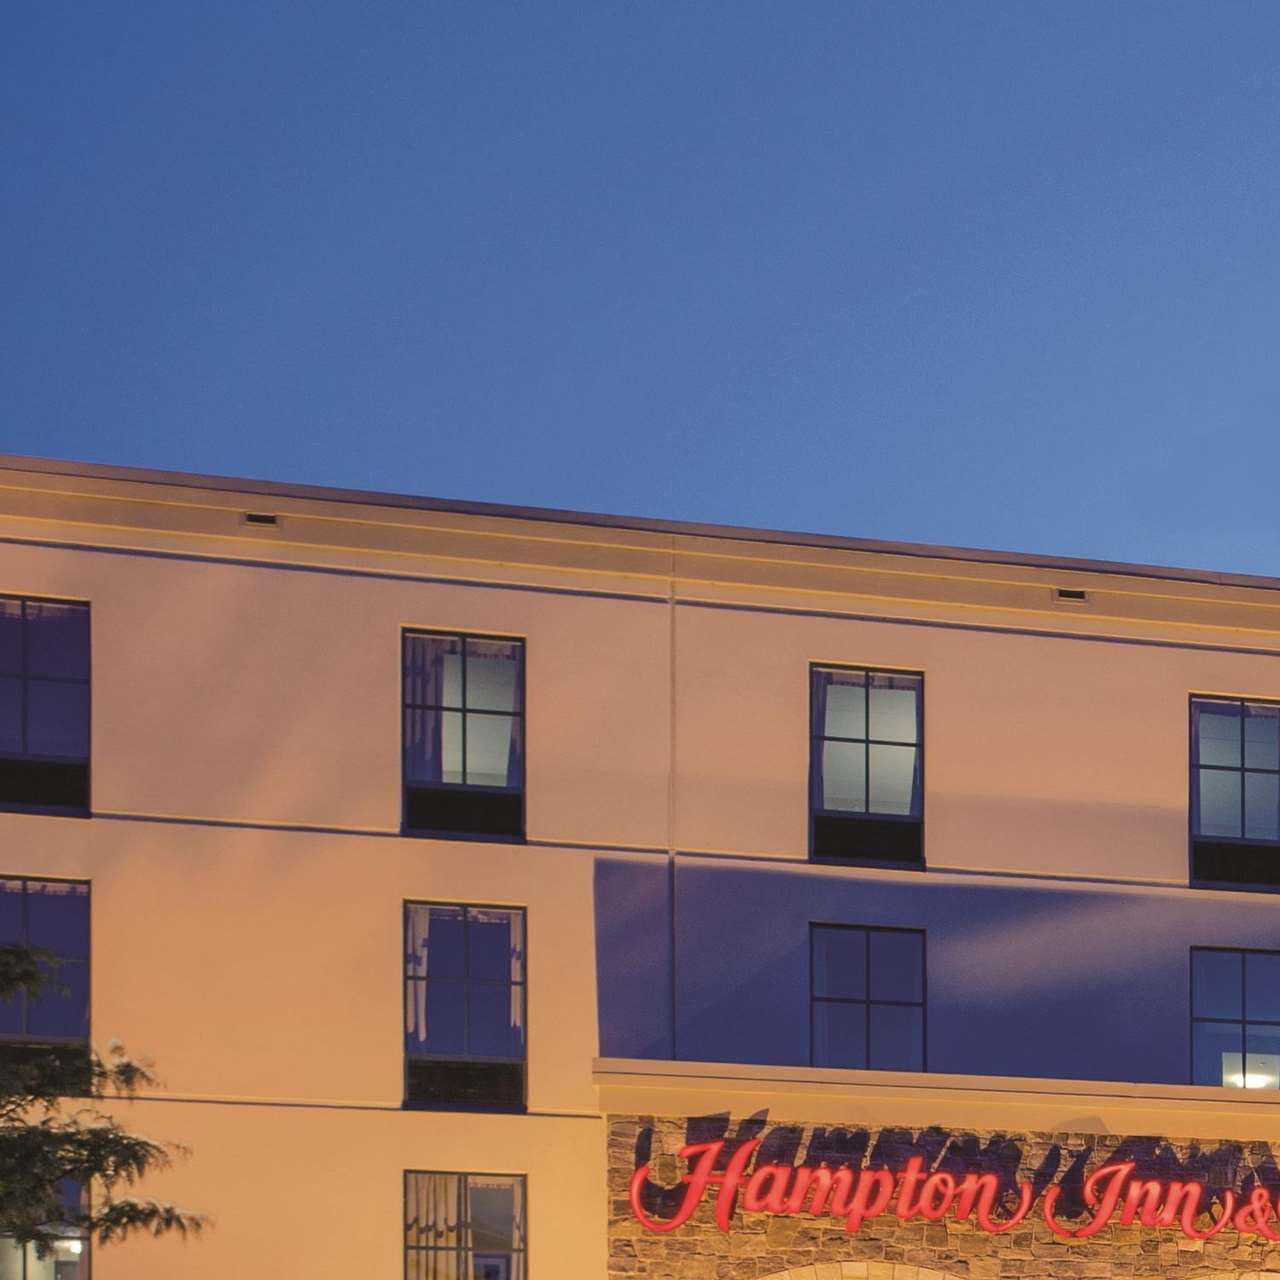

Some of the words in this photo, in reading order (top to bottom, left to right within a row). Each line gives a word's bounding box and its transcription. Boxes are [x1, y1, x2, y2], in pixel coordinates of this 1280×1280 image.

[629, 1137, 1031, 1232] Hampton
[1044, 1162, 1233, 1238] Inn
[1234, 1187, 1280, 1240] &
